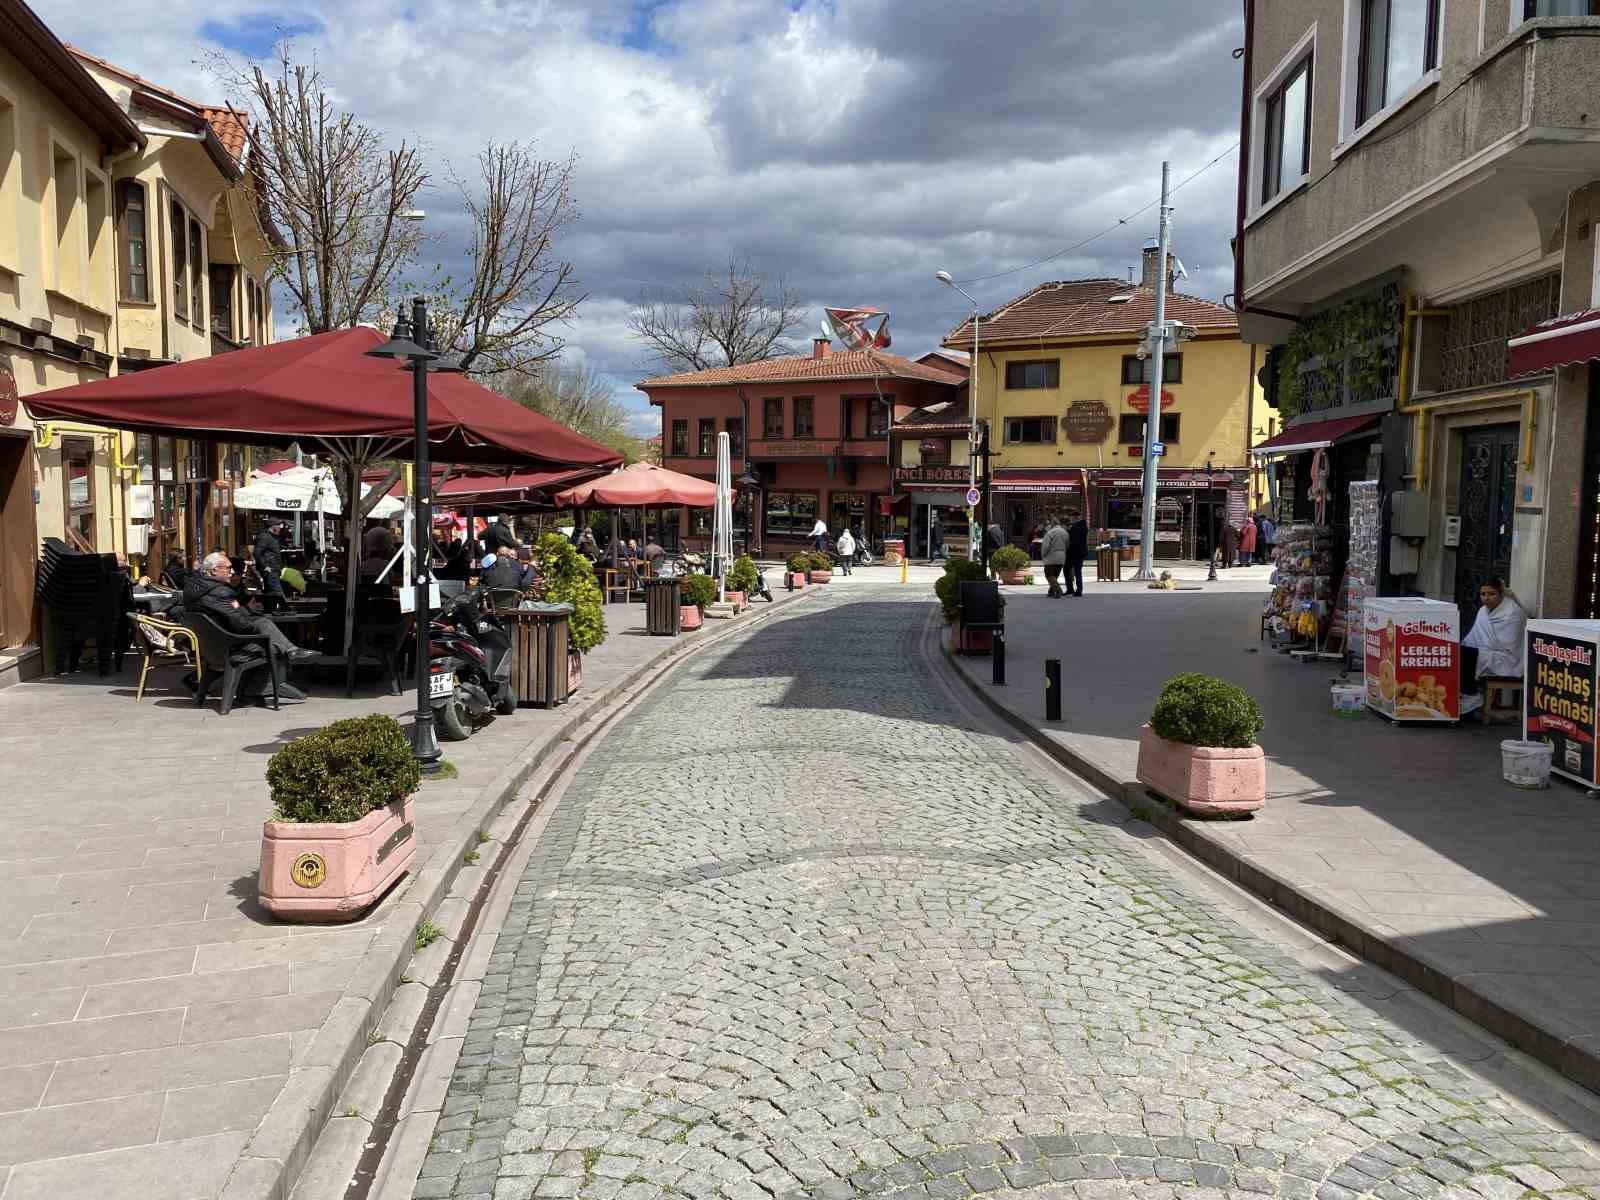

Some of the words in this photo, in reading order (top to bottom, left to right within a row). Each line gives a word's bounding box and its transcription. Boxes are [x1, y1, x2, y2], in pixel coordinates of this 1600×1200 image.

[1401, 643, 1451, 656] LEBLEBİ
[1401, 656, 1451, 668] KREMASI
[1537, 662, 1591, 701] Haşhaş
[1533, 685, 1594, 725] Kreması
